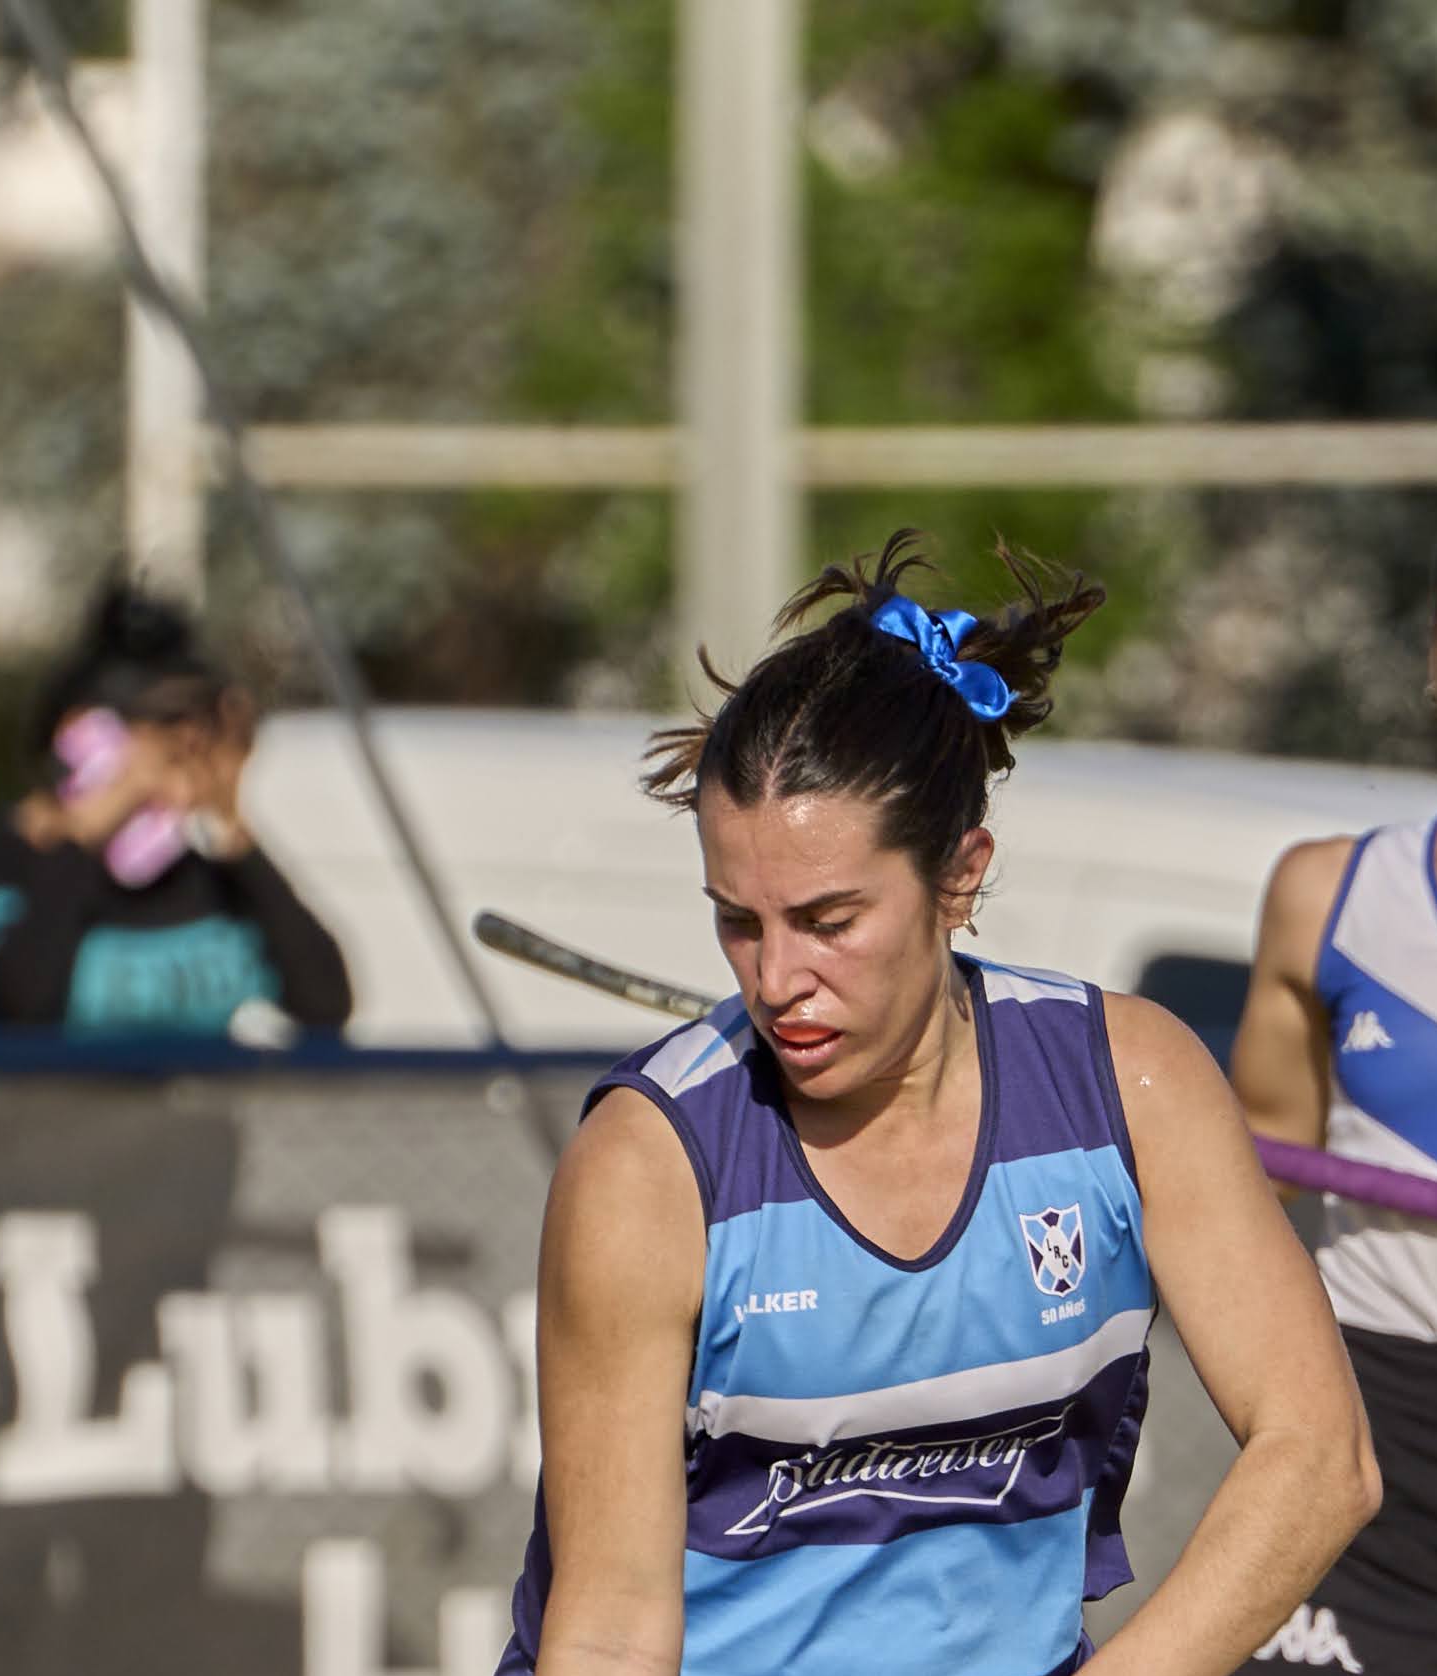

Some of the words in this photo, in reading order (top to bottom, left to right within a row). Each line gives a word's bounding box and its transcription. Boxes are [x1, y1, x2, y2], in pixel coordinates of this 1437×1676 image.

[1045, 1238, 1069, 1268] LRC
[733, 1288, 819, 1324] LKER
[766, 1437, 1035, 1503] Budweiser
